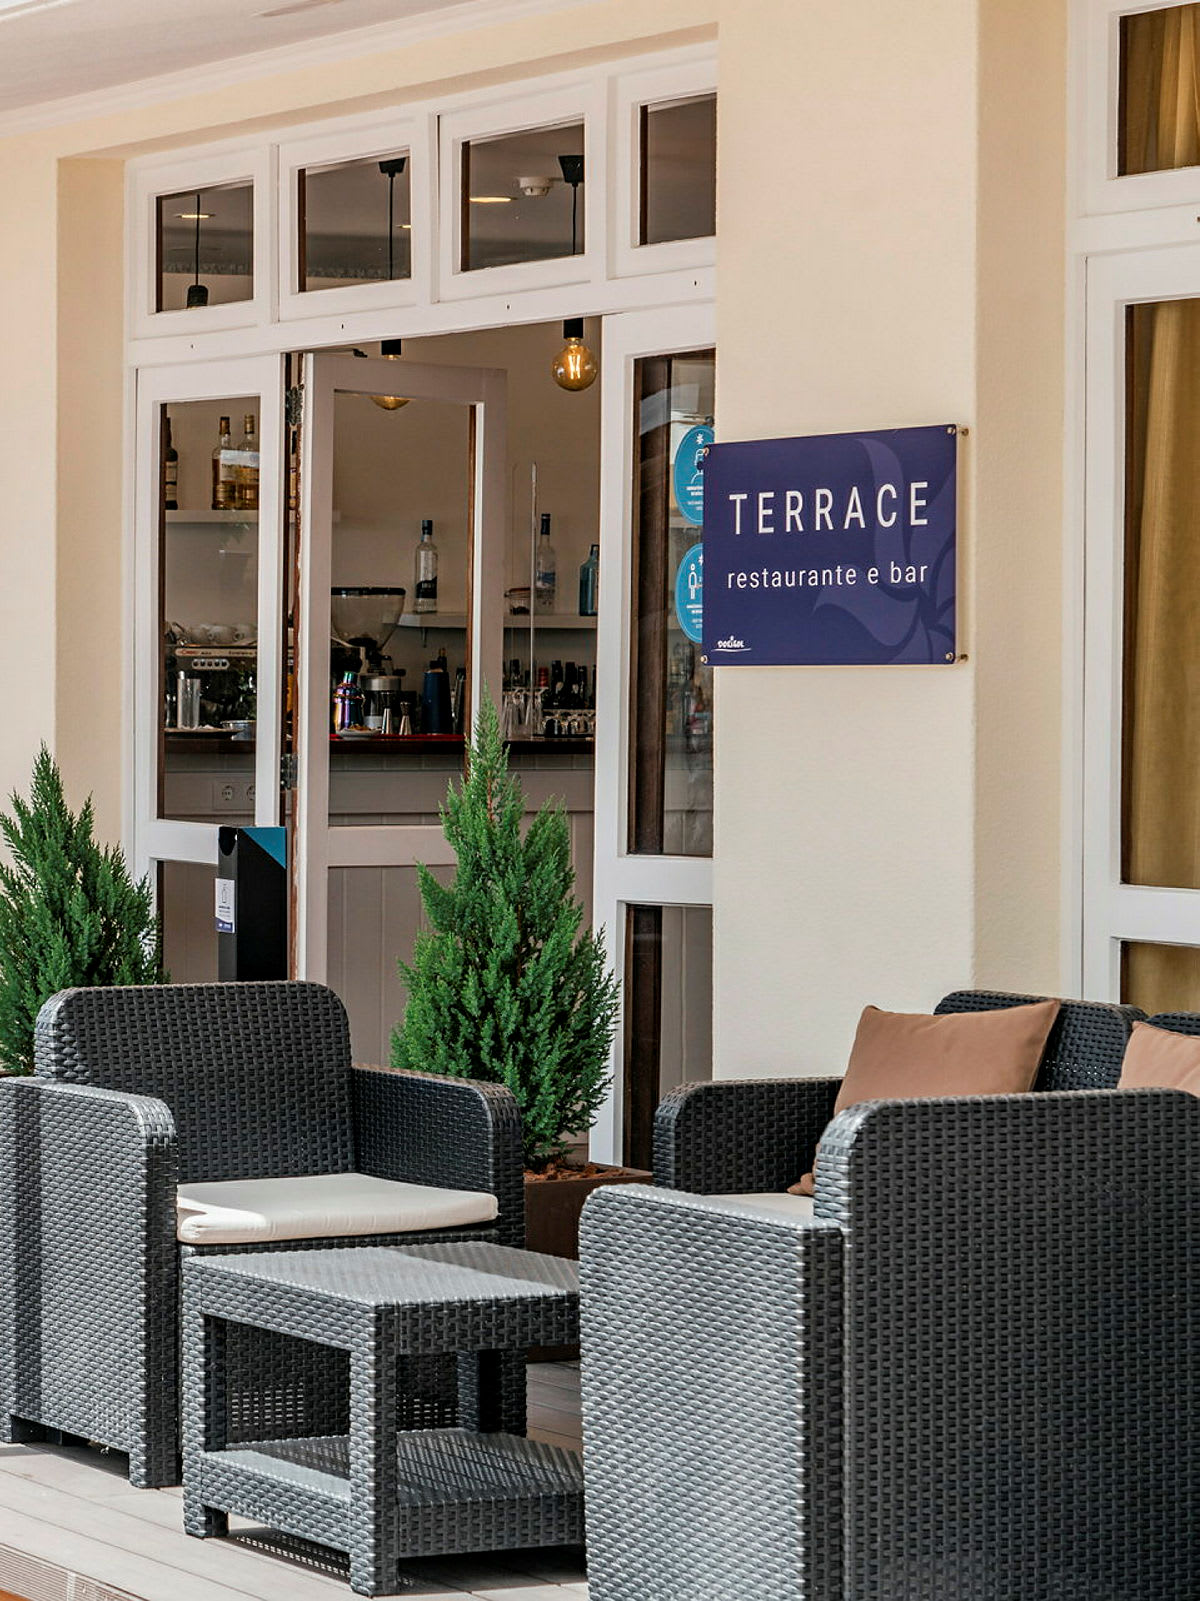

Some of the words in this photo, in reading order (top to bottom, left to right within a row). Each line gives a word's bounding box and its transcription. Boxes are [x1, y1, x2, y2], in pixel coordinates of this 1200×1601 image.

[728, 481, 928, 535] TERRACE
[727, 565, 857, 589] restaurante
[867, 567, 879, 585] e
[890, 560, 929, 584] bar
